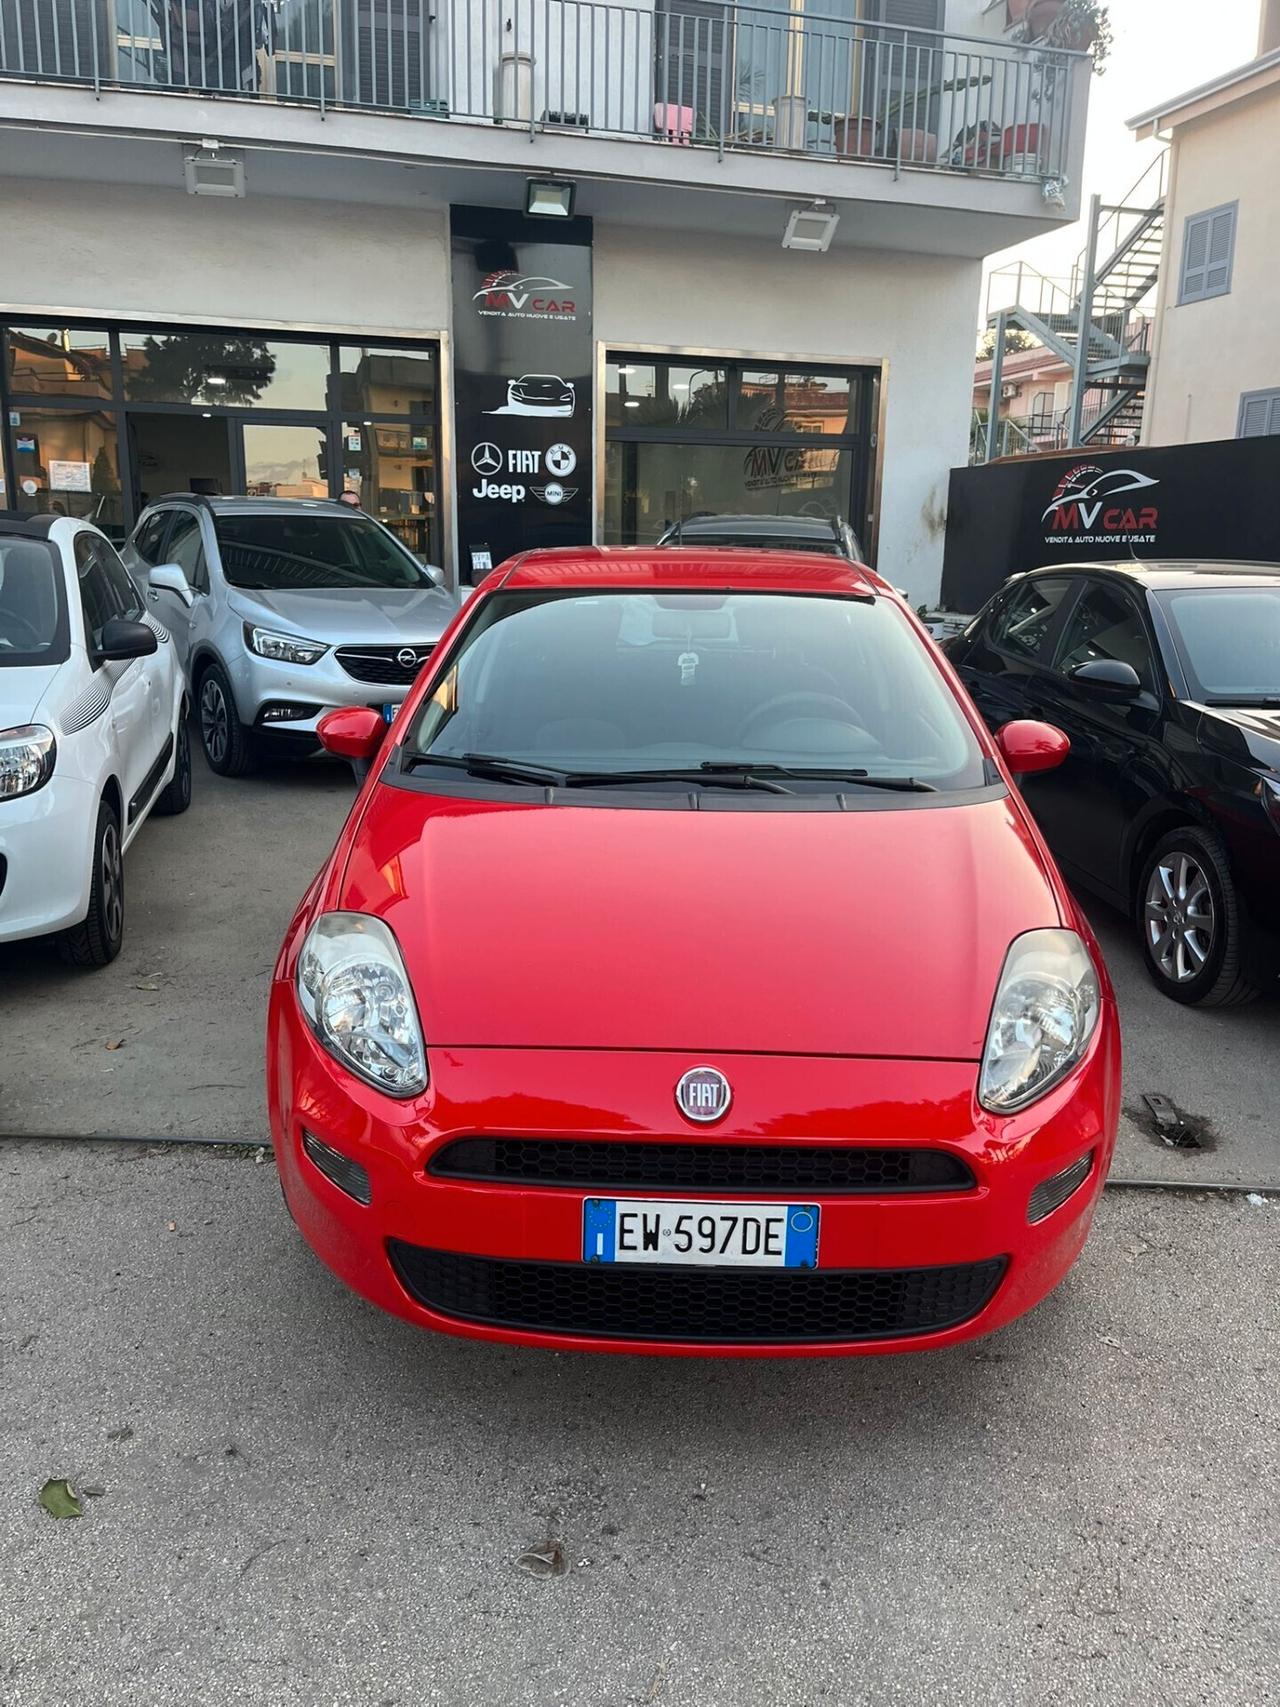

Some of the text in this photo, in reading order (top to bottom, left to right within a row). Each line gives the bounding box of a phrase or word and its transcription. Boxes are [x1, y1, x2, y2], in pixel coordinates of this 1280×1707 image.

[485, 292, 576, 312] MV CAR
[508, 450, 542, 473] FIAT
[473, 479, 525, 503] Jeep
[1052, 502, 1159, 530] MV CAR
[1045, 536, 1073, 544] VENDITA
[1128, 535, 1156, 543] USATE
[689, 1083, 720, 1108] FIAT
